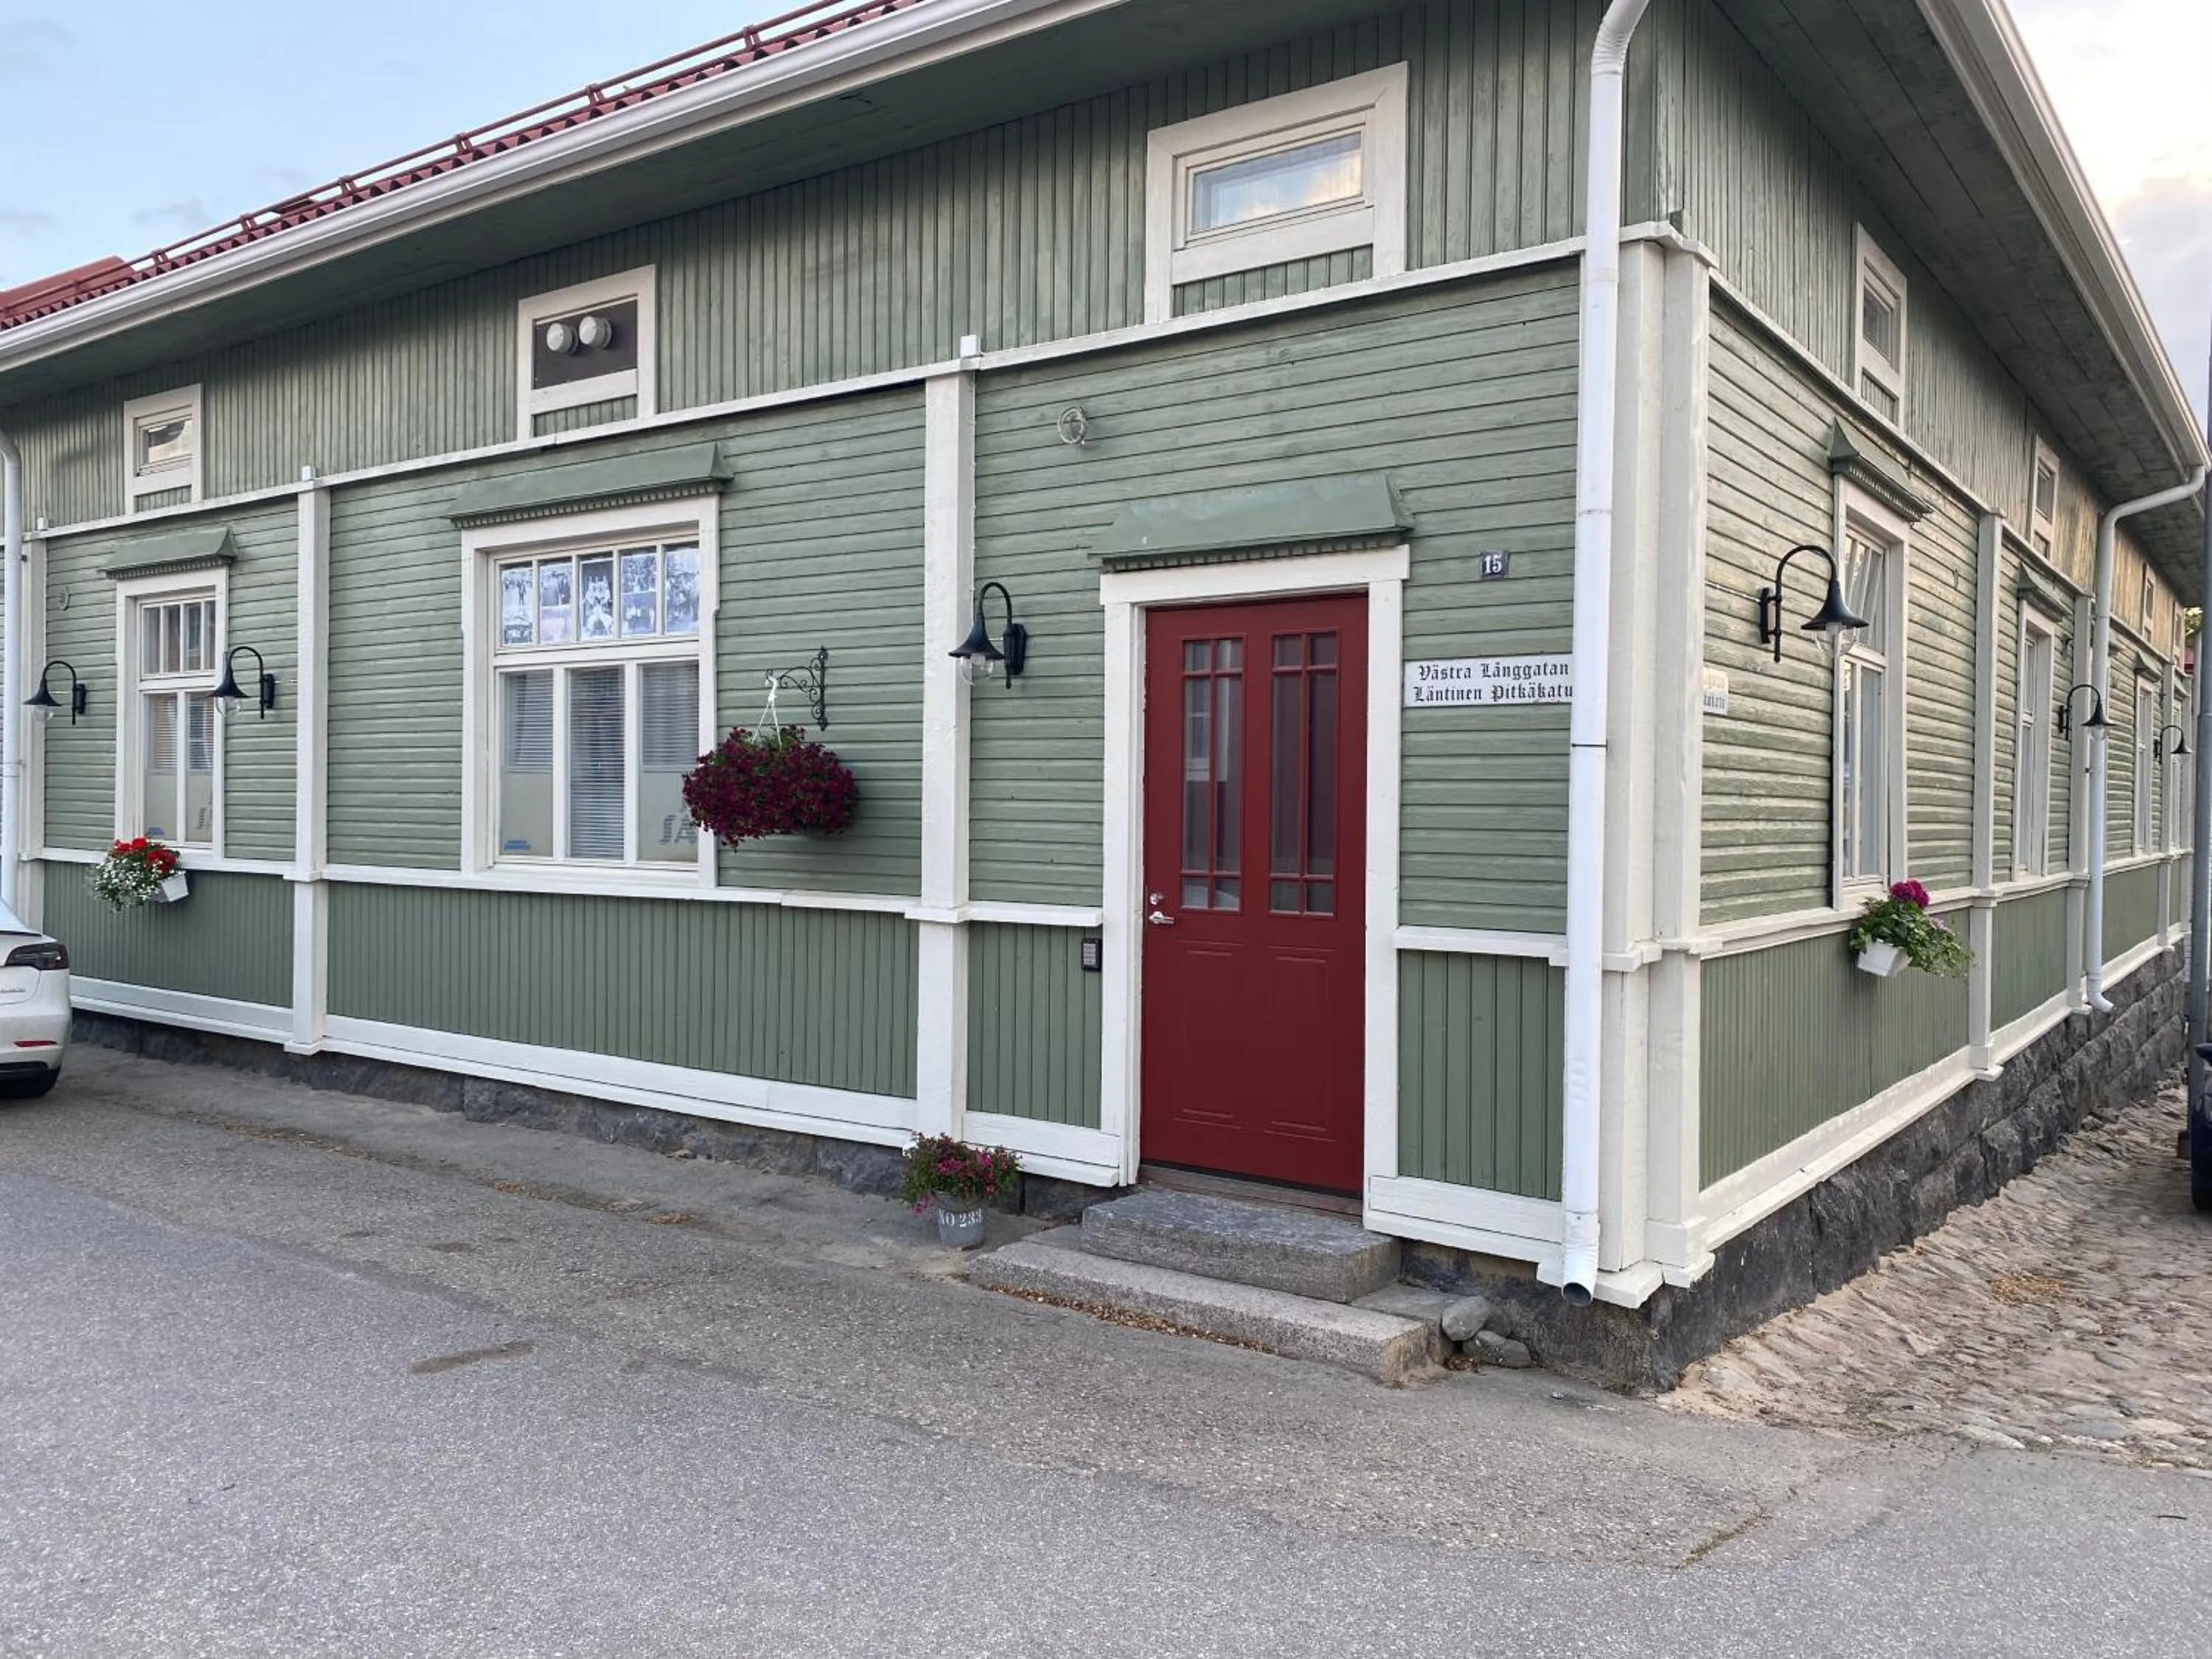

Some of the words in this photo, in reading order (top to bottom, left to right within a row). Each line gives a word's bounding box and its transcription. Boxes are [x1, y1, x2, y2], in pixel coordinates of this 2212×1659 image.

[1484, 554, 1502, 574] 15
[1418, 664, 1472, 681] Västra
[1481, 661, 1569, 680] Långgatan
[1413, 685, 1482, 702] Läntinen
[1491, 682, 1573, 702] Pitkäkatu
